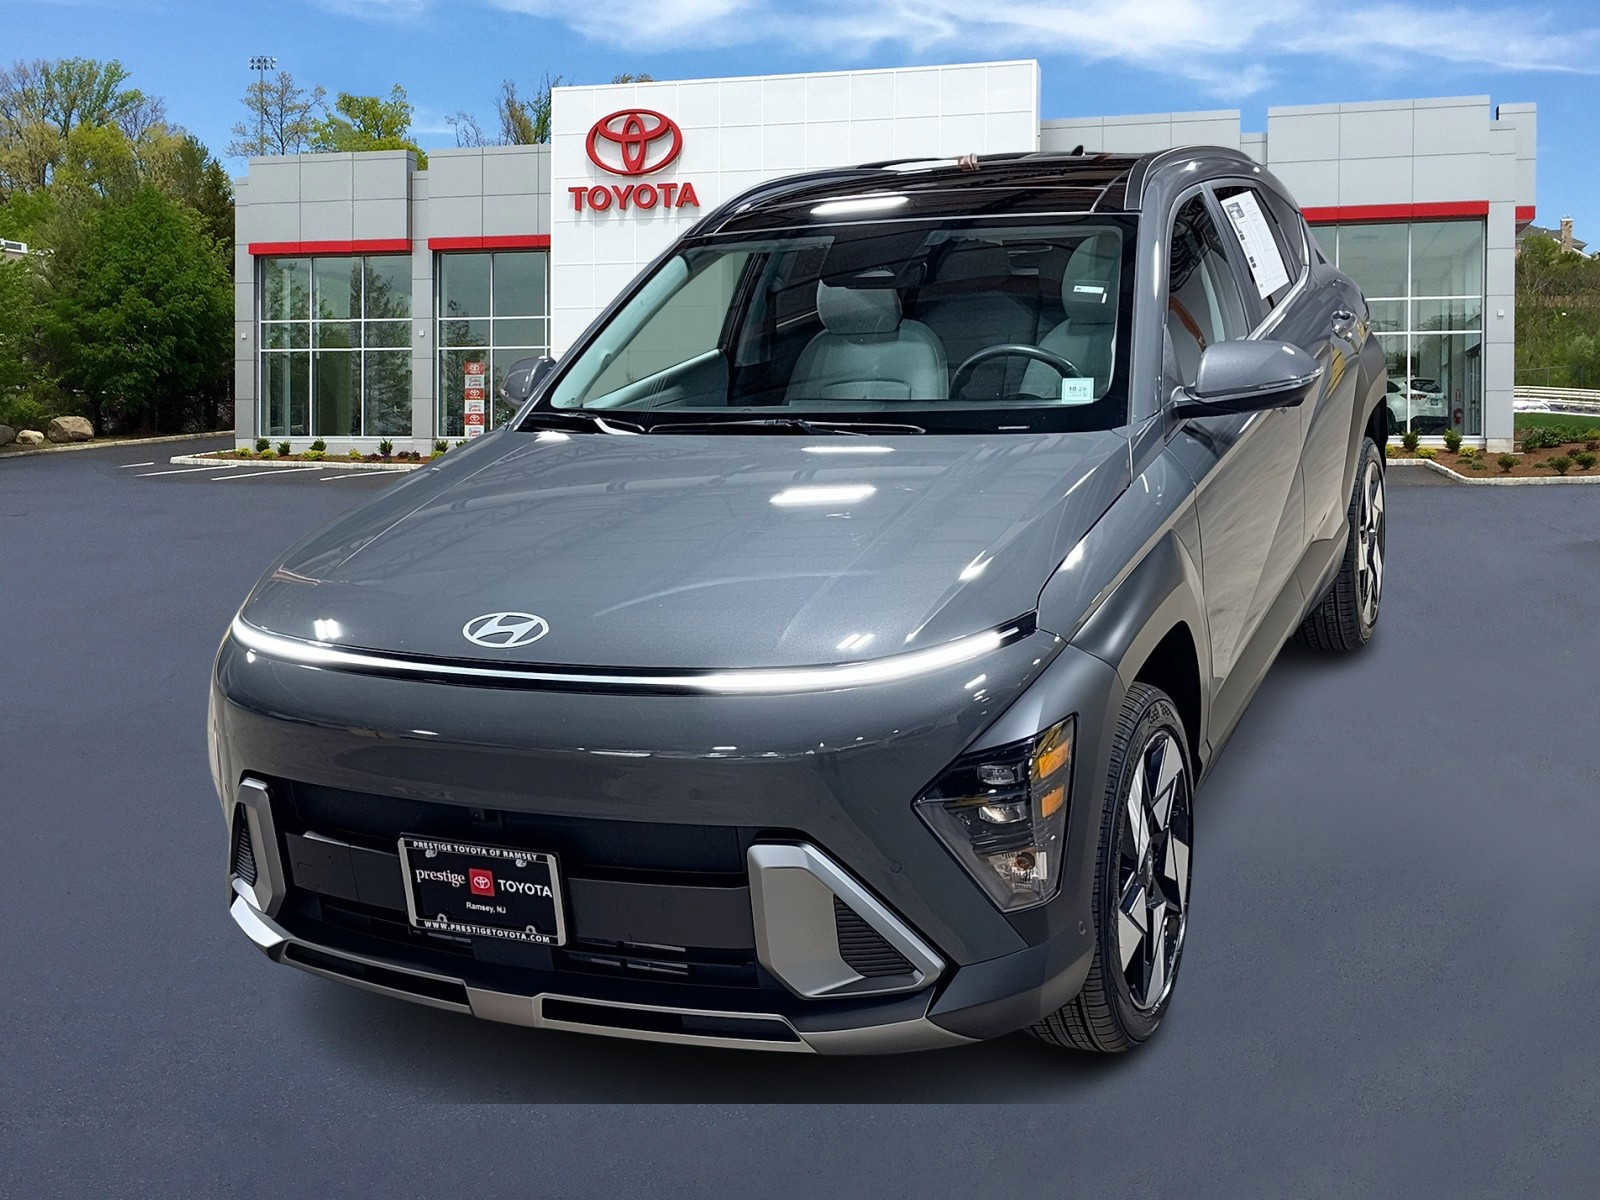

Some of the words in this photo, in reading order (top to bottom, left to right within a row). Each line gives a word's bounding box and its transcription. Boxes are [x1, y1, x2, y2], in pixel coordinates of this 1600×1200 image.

[568, 182, 700, 211] TOYOTA
[413, 840, 451, 852] PRESTIGE
[454, 845, 487, 857] TOYOTA
[489, 849, 500, 857] OF
[503, 850, 537, 861] RAMSEY
[415, 868, 466, 888] prestige
[497, 879, 553, 898] TOYOTA
[466, 901, 495, 915] Ramsey,
[496, 906, 507, 914] NJ
[424, 920, 550, 944] WWW.PRESTIGETOYOTA.COM
